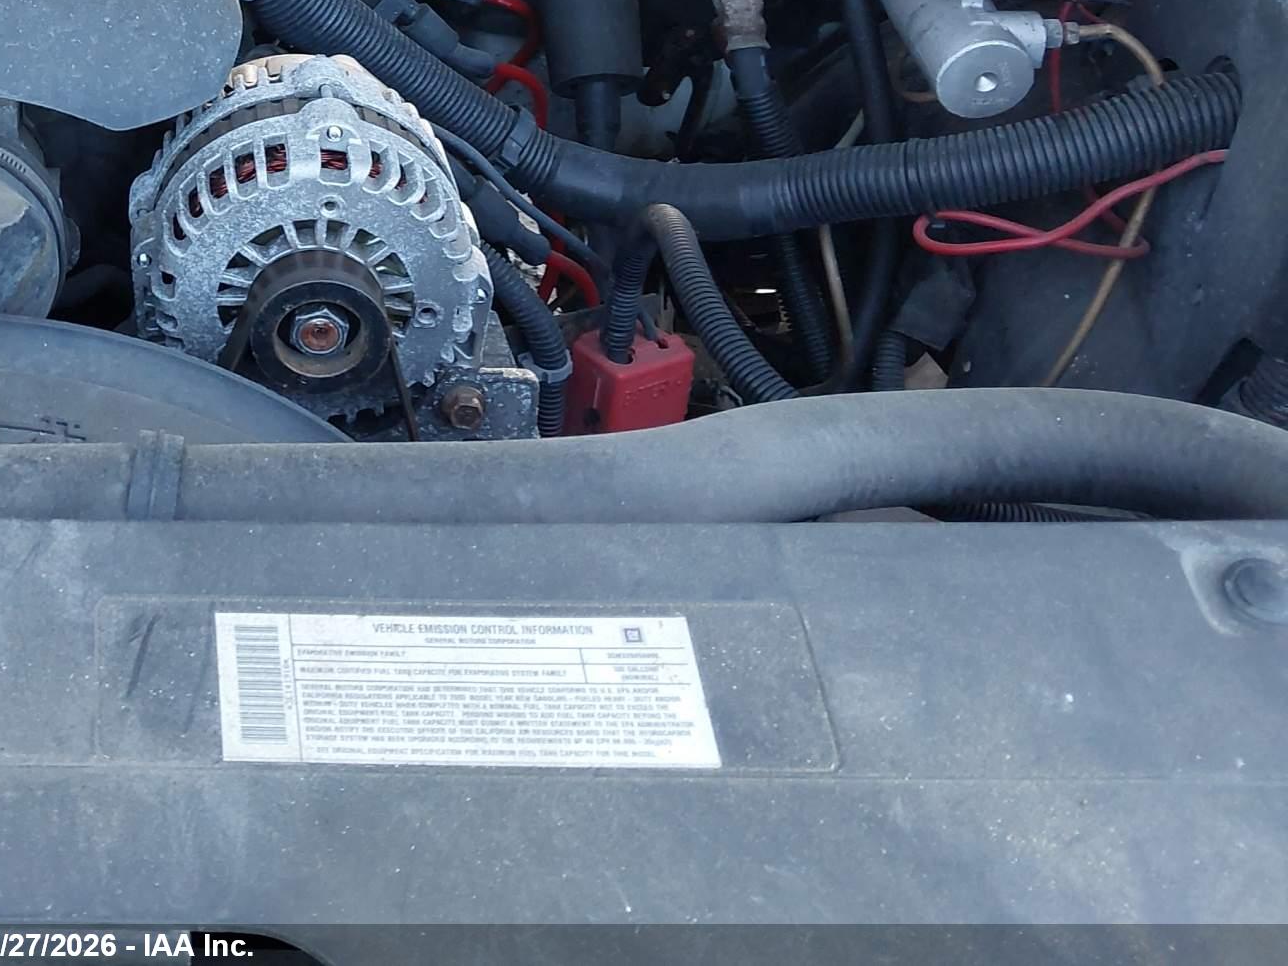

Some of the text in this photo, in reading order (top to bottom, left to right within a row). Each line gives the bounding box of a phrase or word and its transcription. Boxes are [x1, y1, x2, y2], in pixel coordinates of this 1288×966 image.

[372, 623, 594, 635] VEHICLE EMISSION CONTROL INFORMATION
